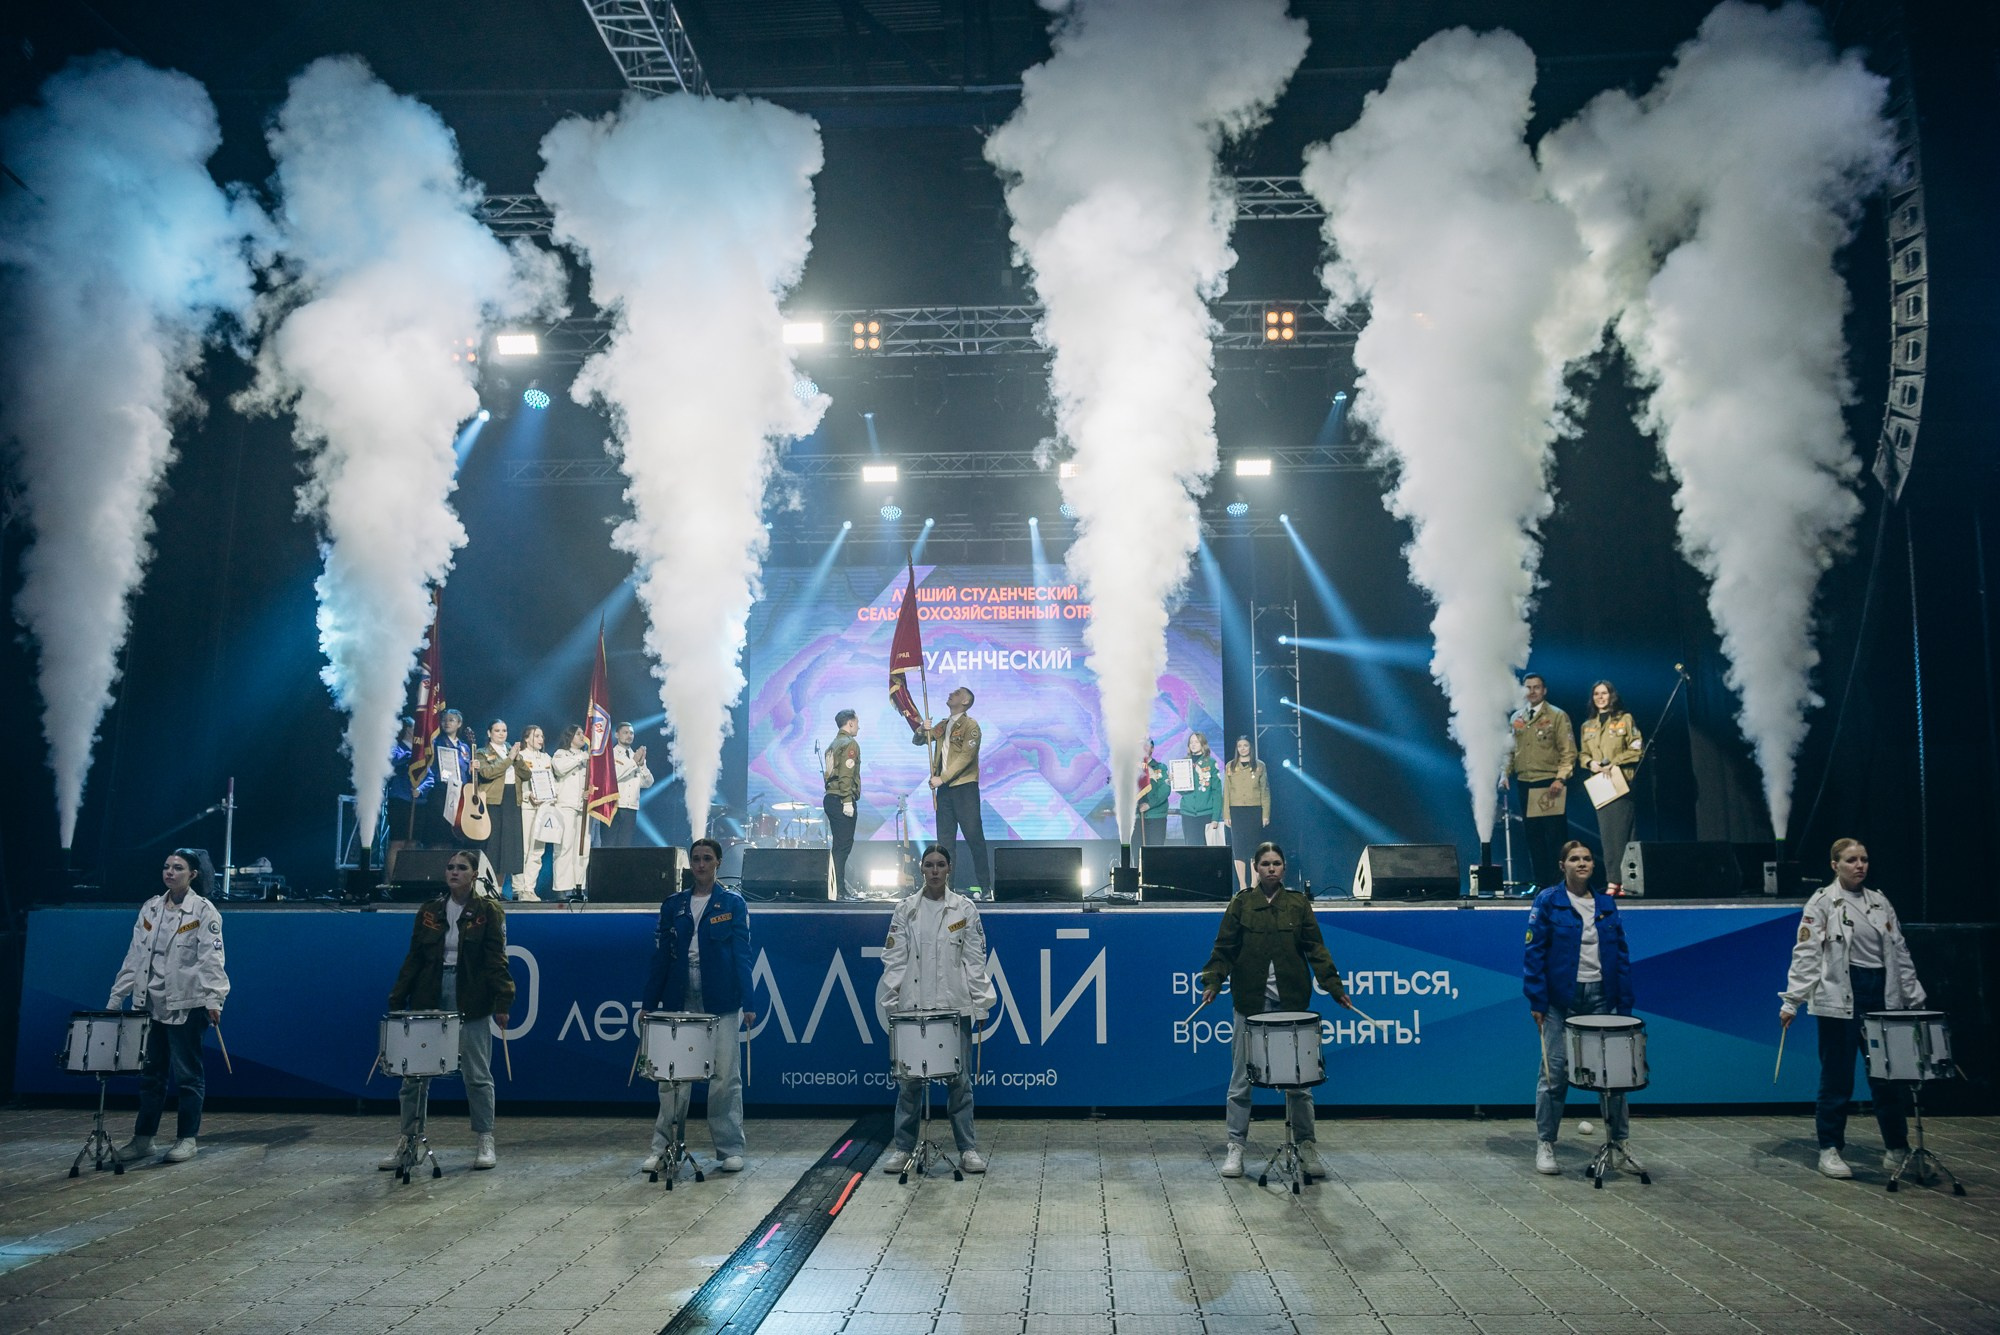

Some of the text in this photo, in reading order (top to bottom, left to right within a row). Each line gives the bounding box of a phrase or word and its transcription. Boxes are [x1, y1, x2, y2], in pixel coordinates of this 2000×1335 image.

[891, 584, 1078, 603] ЛЧШИЙ СТУДЕНЧЕСКИЙ
[857, 603, 1060, 621] СЕЛЬОХОЗЯЙСТВЕННЫЙ
[922, 647, 1072, 674] УДЕНЧЕСКИЙ
[739, 928, 1107, 1046] АЛАЙ
[1173, 1009, 1421, 1054] вре енять!
[781, 1069, 858, 1089] краевой
[1001, 1069, 1058, 1090] отряд
